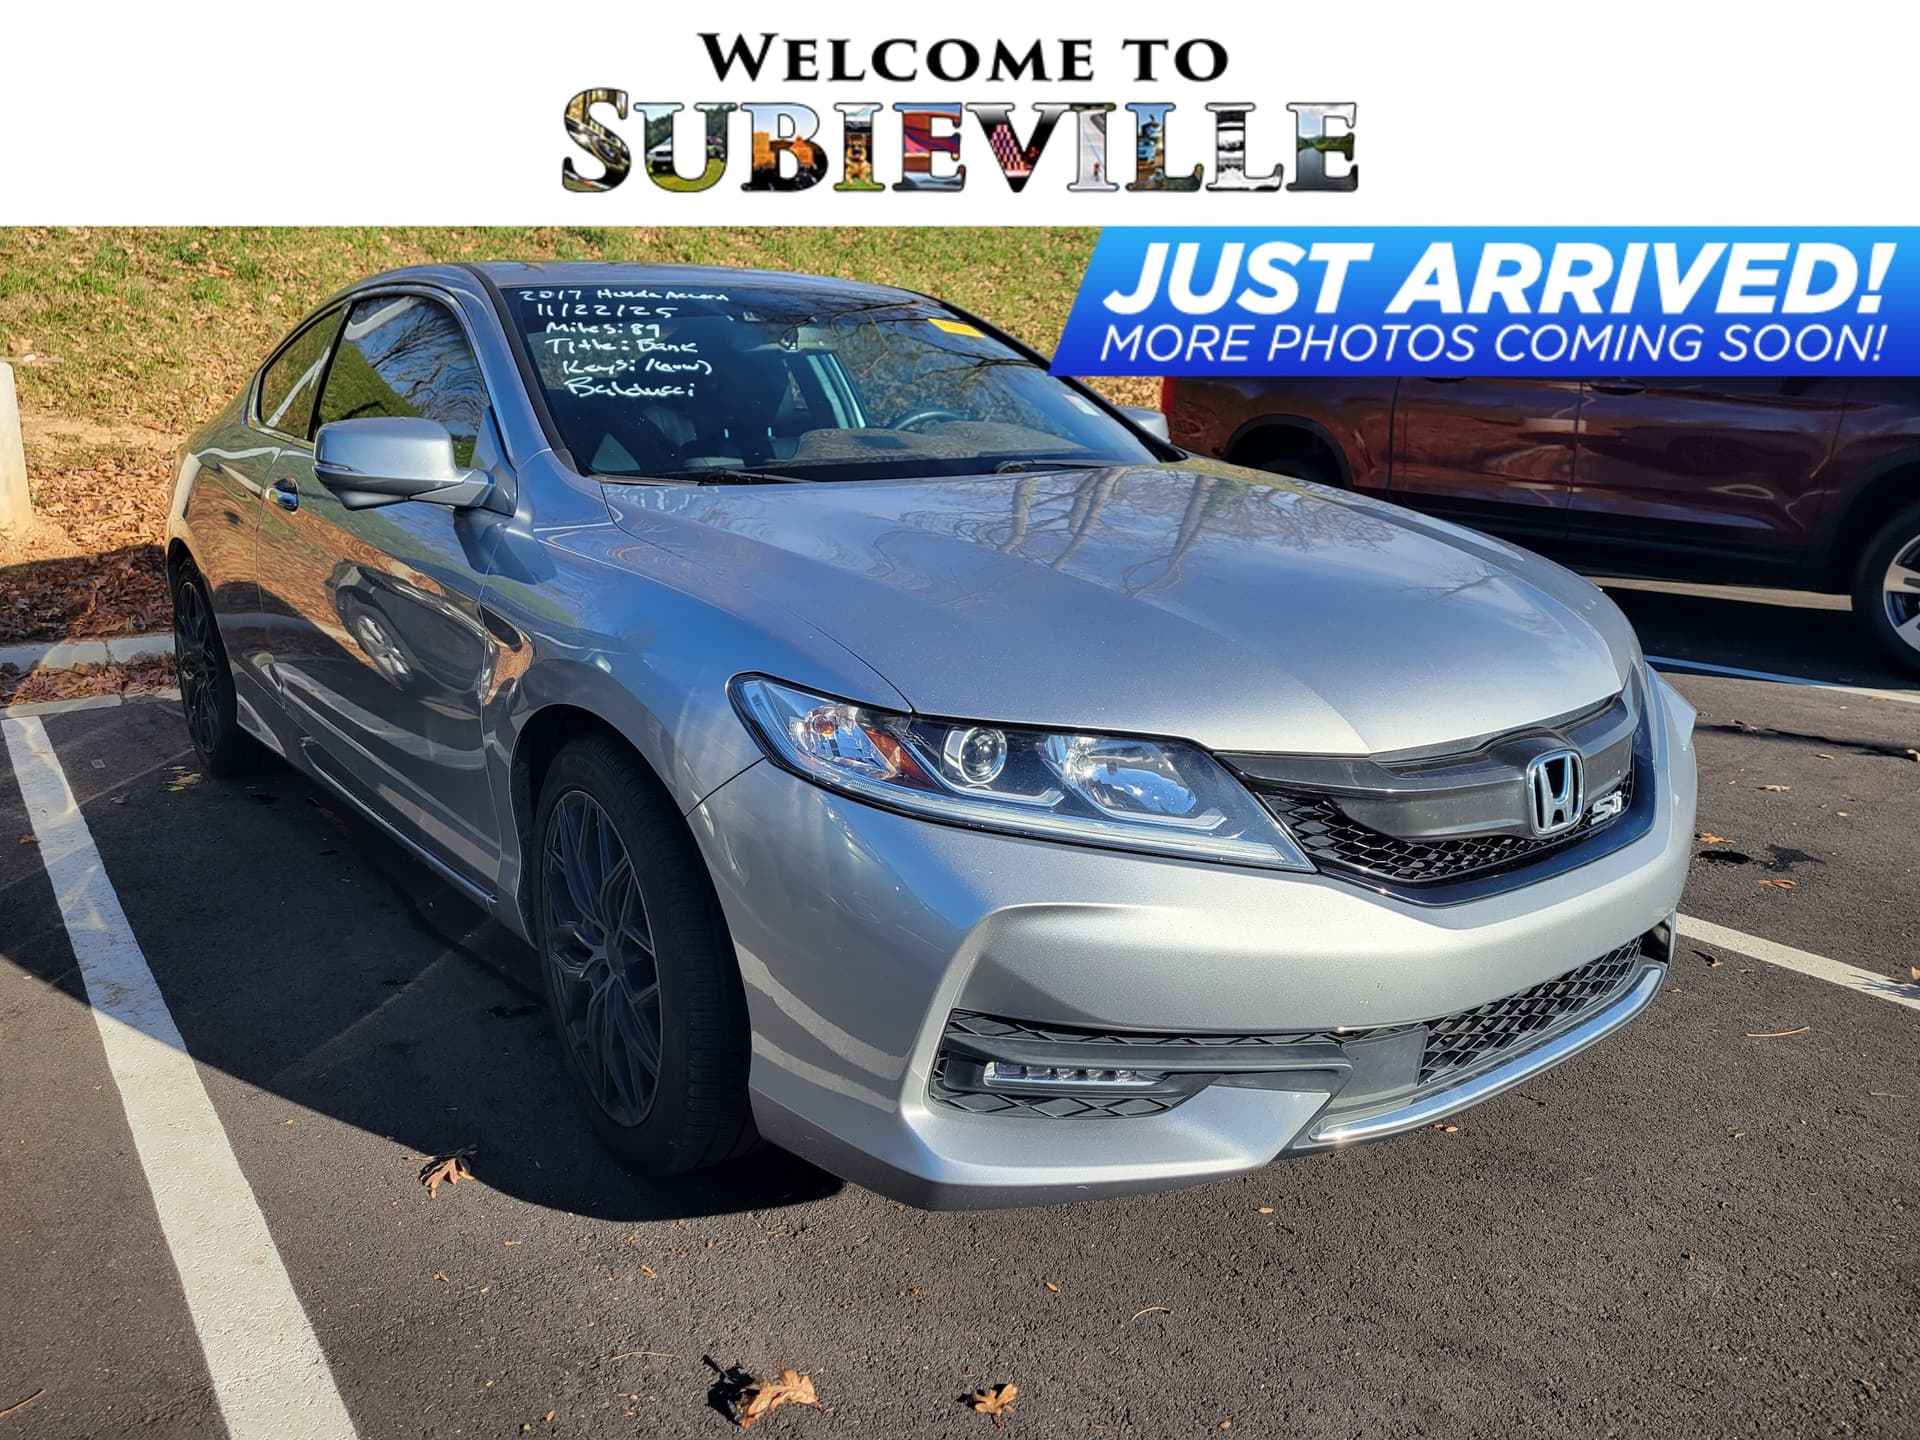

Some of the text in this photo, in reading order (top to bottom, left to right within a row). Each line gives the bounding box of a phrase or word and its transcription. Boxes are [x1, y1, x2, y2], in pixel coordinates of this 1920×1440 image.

[519, 290, 582, 300] 2017
[537, 303, 679, 318] 11/22/25
[630, 323, 660, 338] 89
[636, 338, 698, 353] Bank
